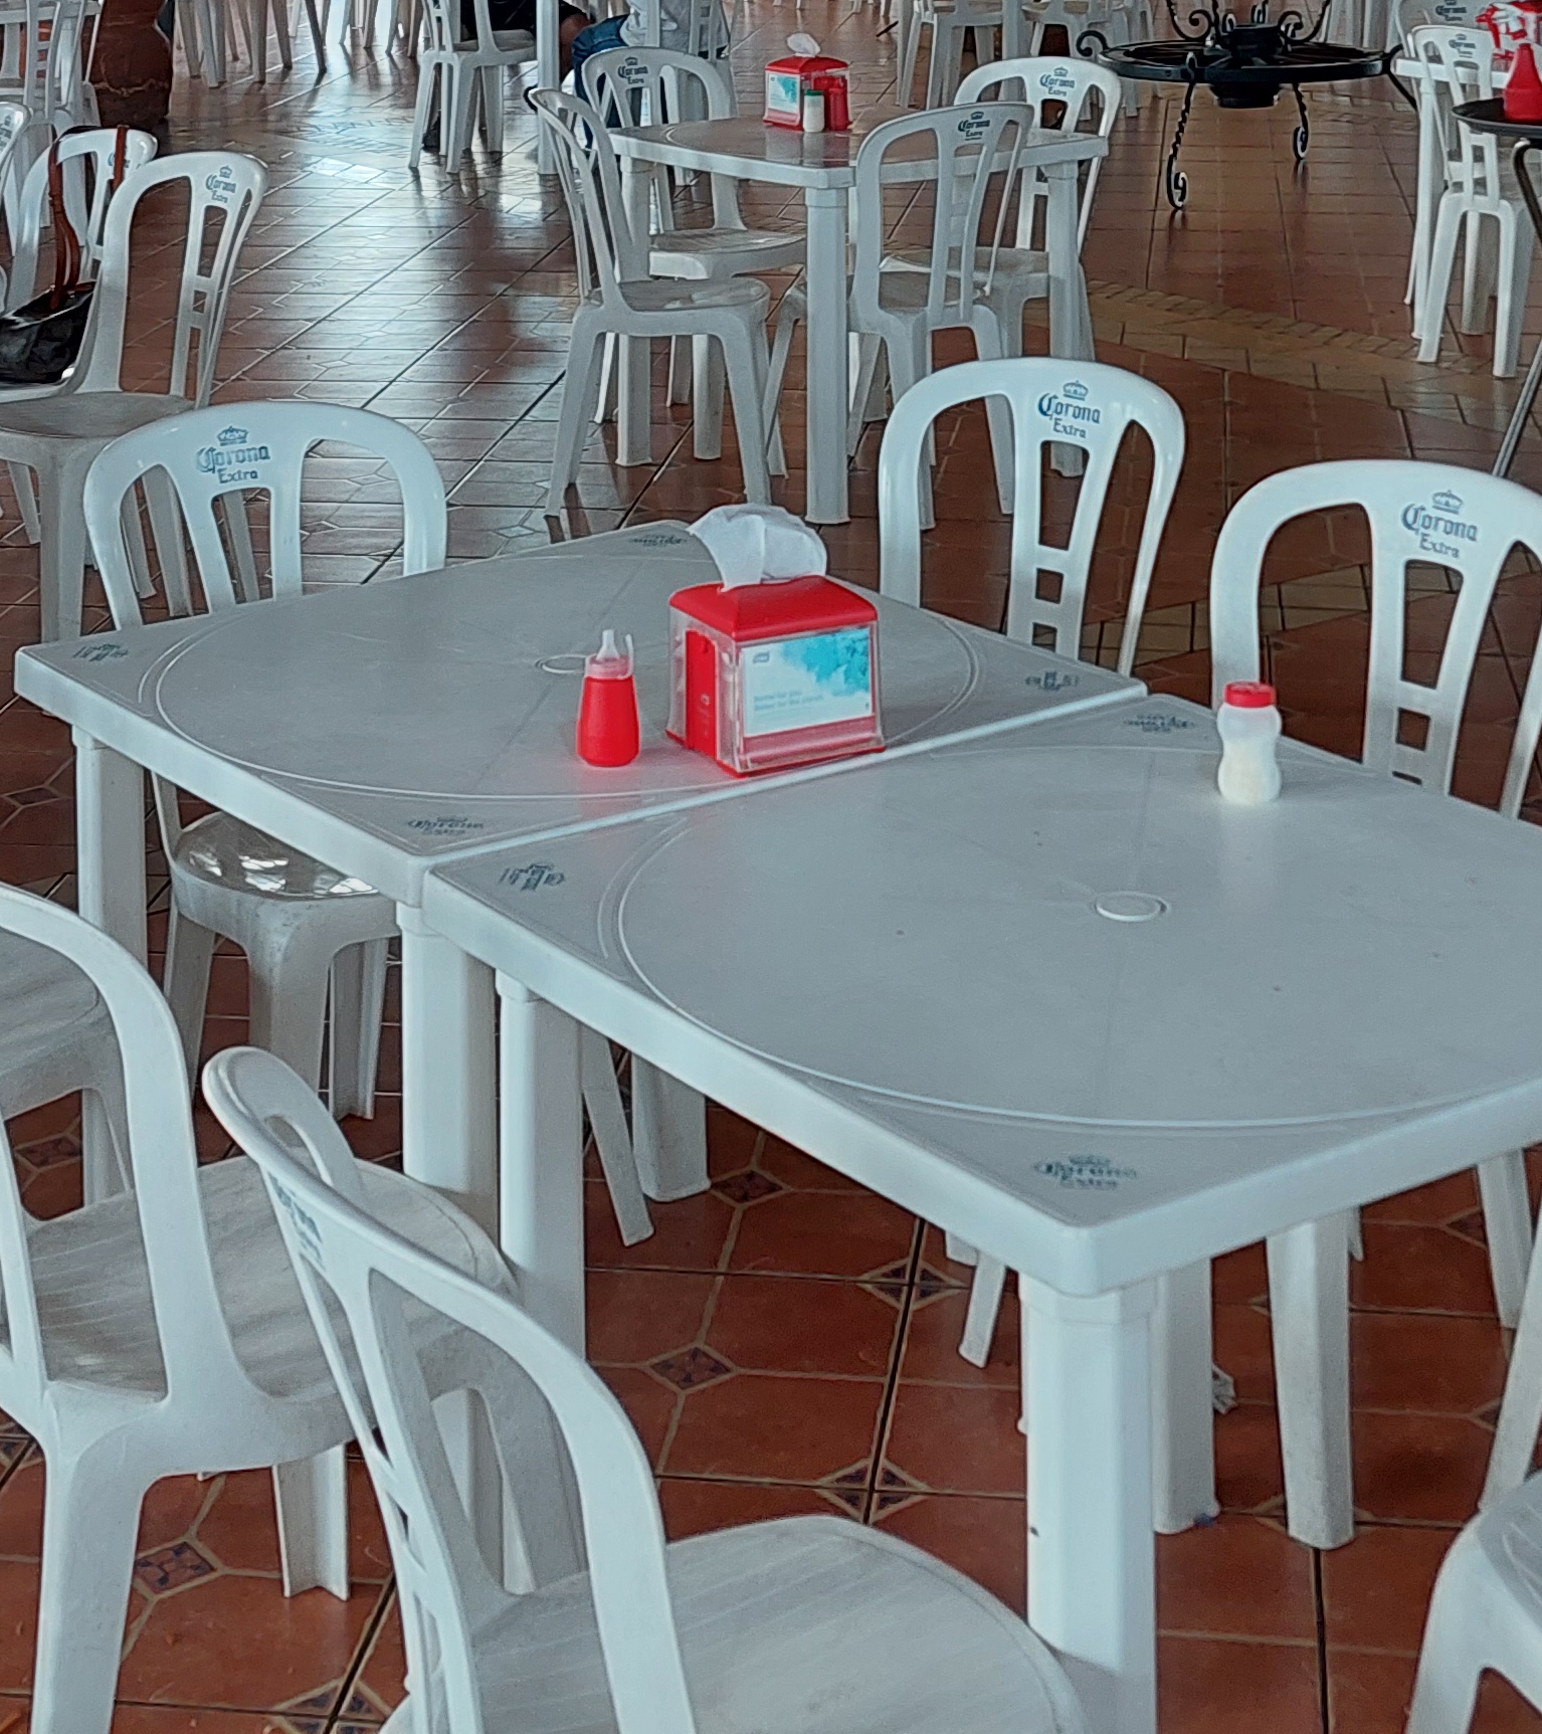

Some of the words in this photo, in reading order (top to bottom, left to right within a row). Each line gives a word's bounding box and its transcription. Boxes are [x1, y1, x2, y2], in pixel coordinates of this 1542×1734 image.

[1038, 392, 1101, 424] Corona
[1052, 417, 1087, 439] Extra
[196, 446, 271, 473] Corona
[218, 468, 259, 484] Extra
[1402, 503, 1478, 542] Corona
[1419, 533, 1460, 559] Extra
